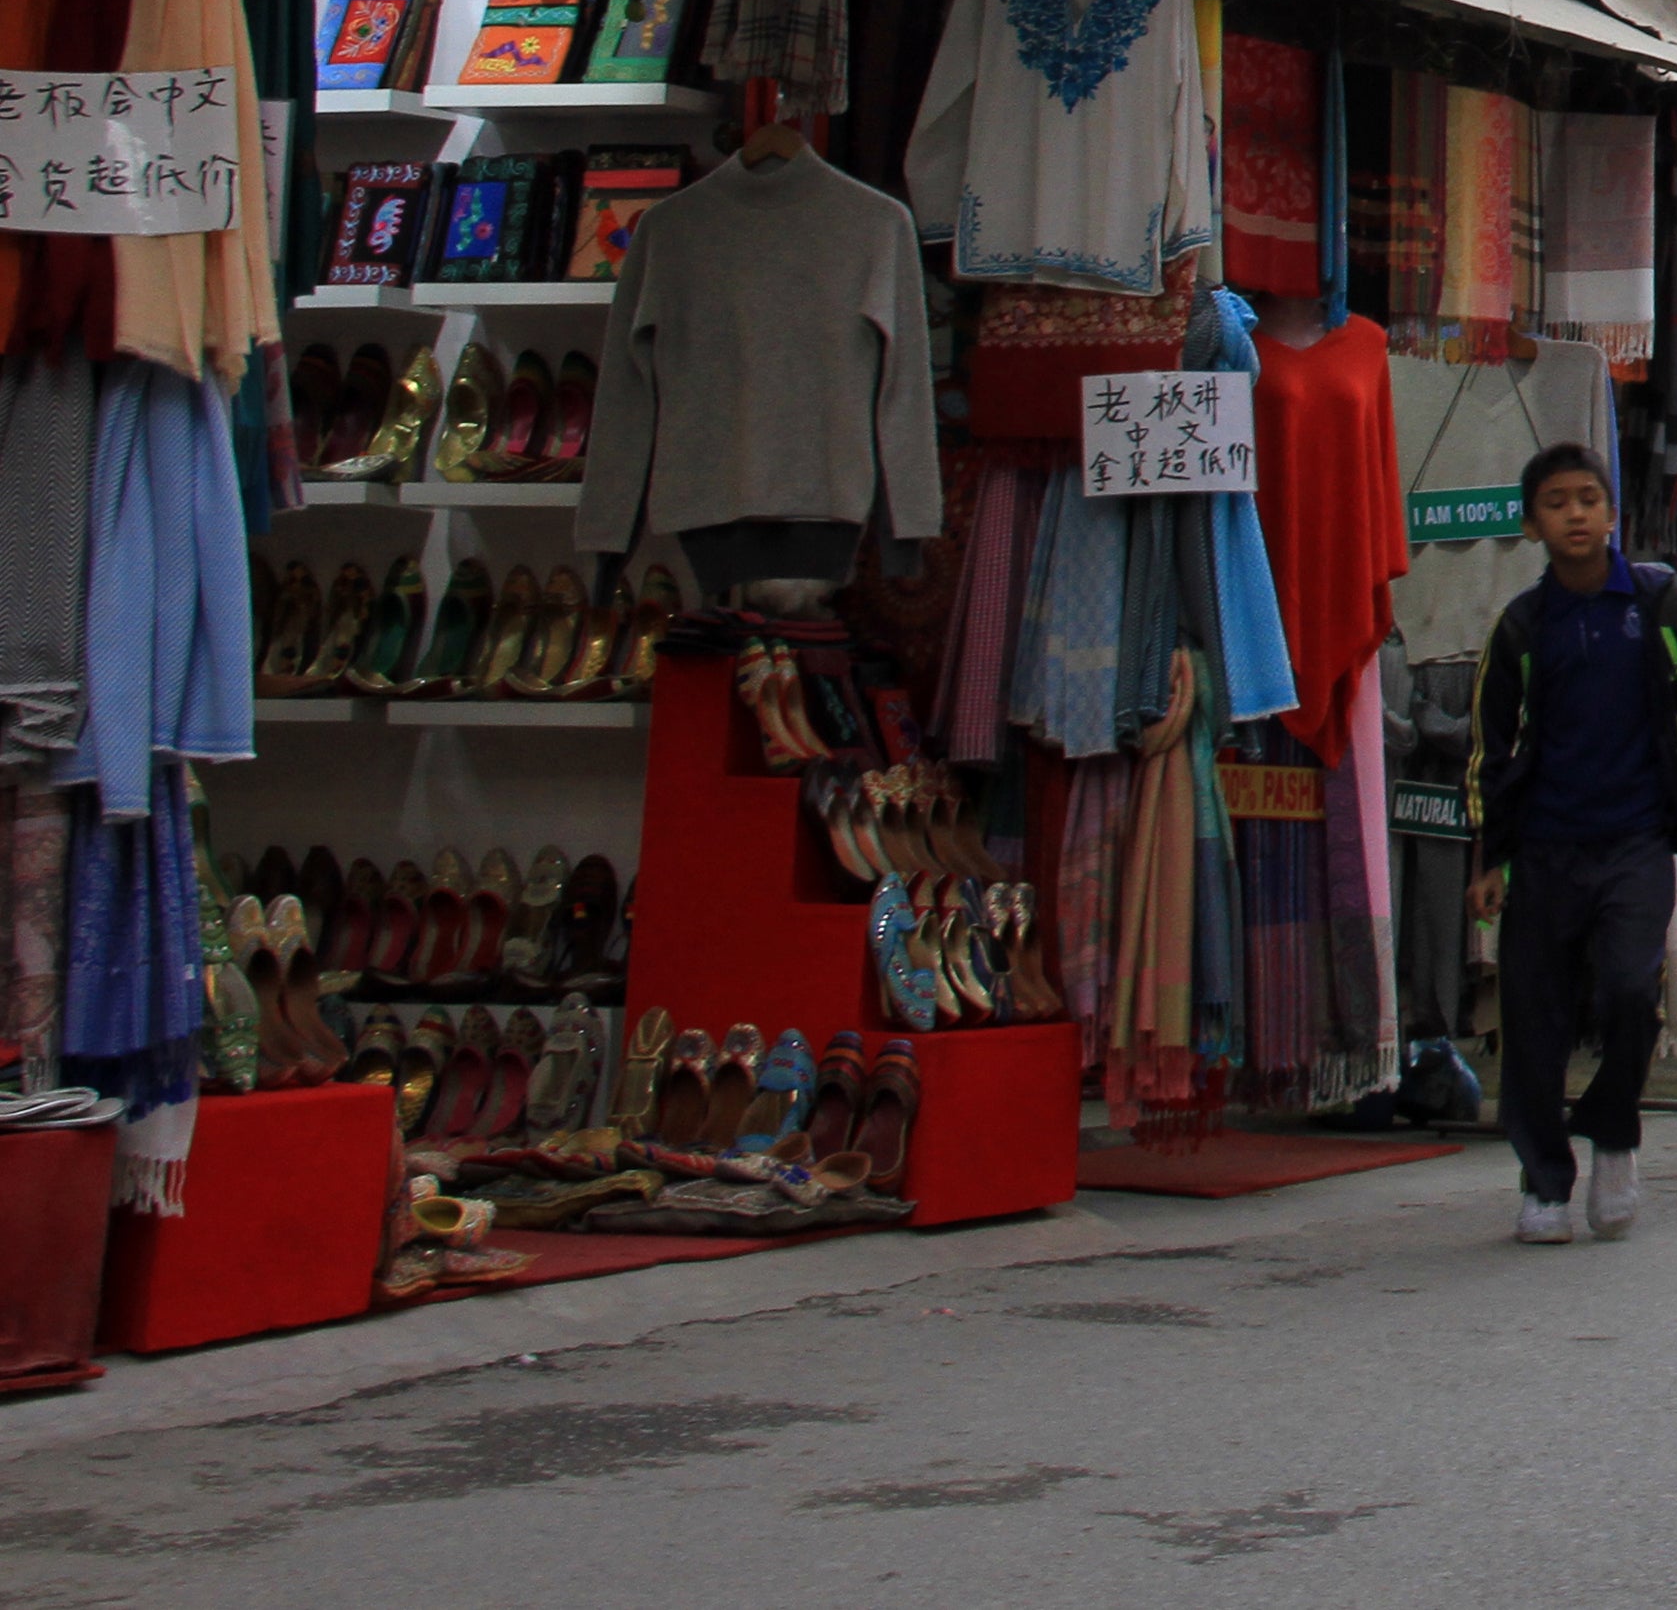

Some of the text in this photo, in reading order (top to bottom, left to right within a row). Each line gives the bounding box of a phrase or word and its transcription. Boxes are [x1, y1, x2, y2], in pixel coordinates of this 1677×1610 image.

[1126, 421, 1208, 449] 中文
[1413, 507, 1419, 527] I
[1425, 504, 1451, 526] AM
[1457, 501, 1503, 523] 100%
[1394, 792, 1457, 827] NATURAL
